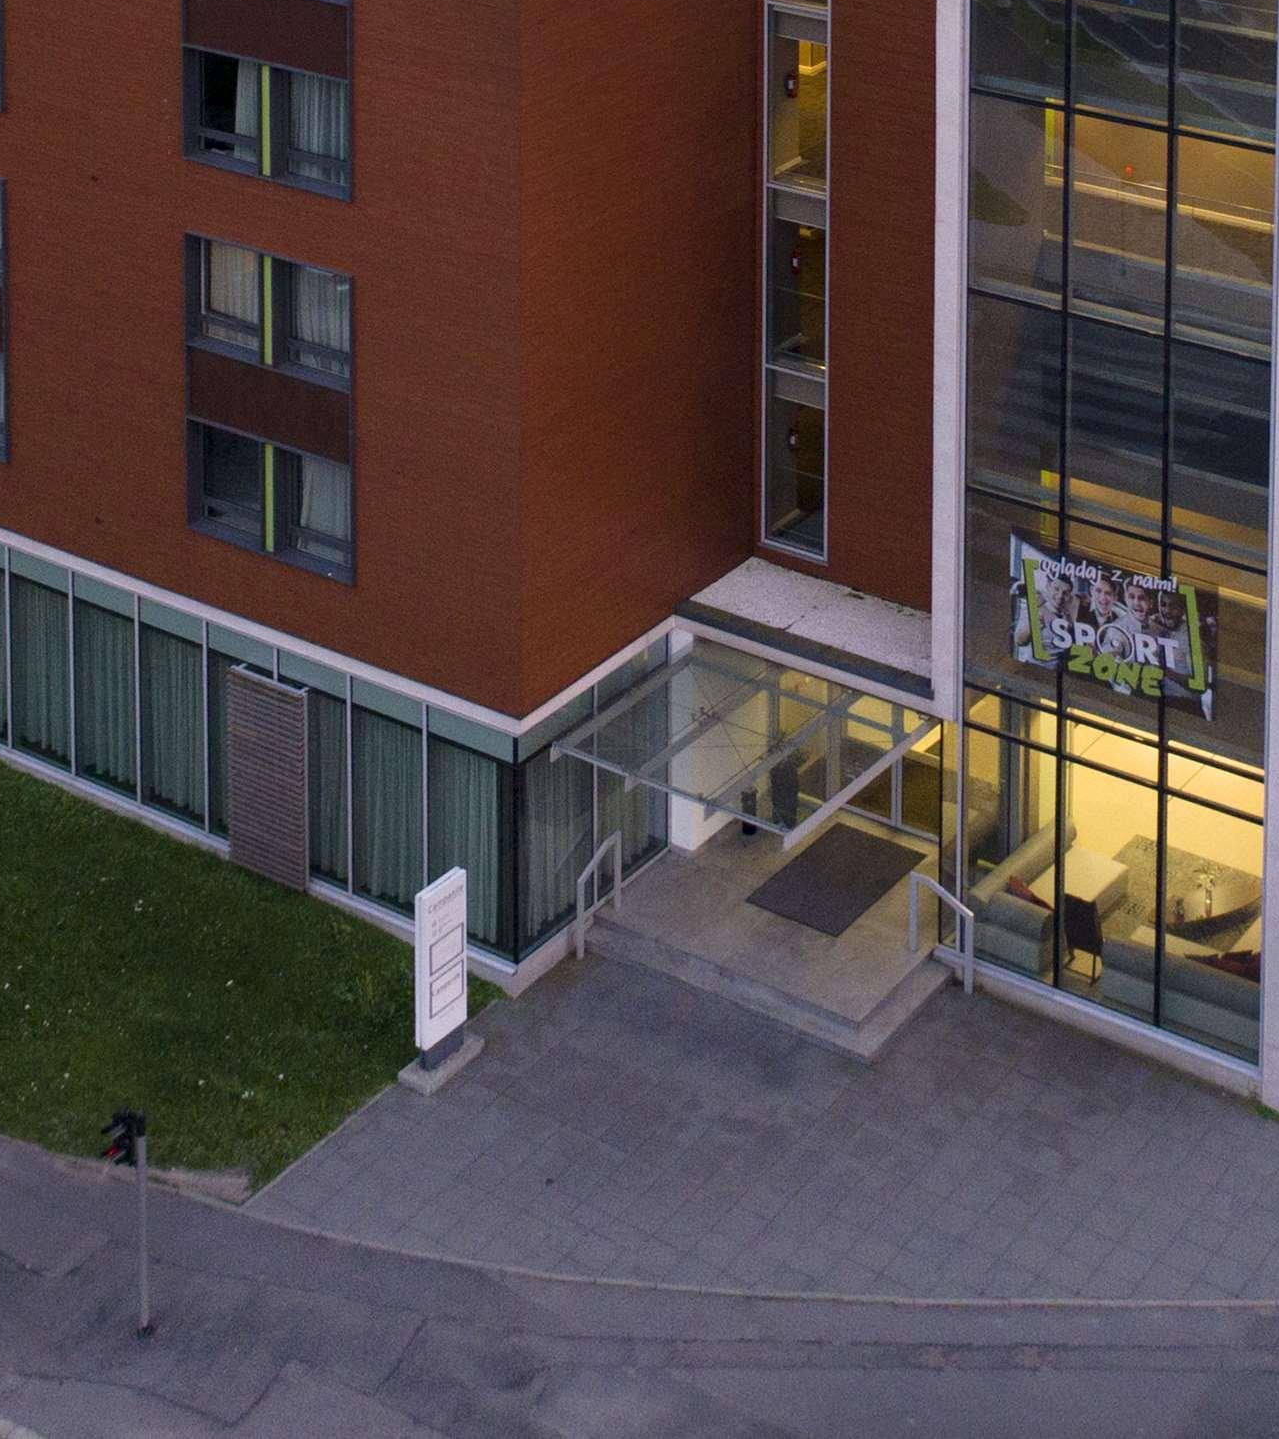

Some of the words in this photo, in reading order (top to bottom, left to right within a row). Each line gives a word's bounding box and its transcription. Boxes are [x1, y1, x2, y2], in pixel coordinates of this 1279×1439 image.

[1133, 574, 1177, 593] nami!
[1050, 619, 1179, 670] SPORT
[1068, 644, 1163, 697] ZONE
